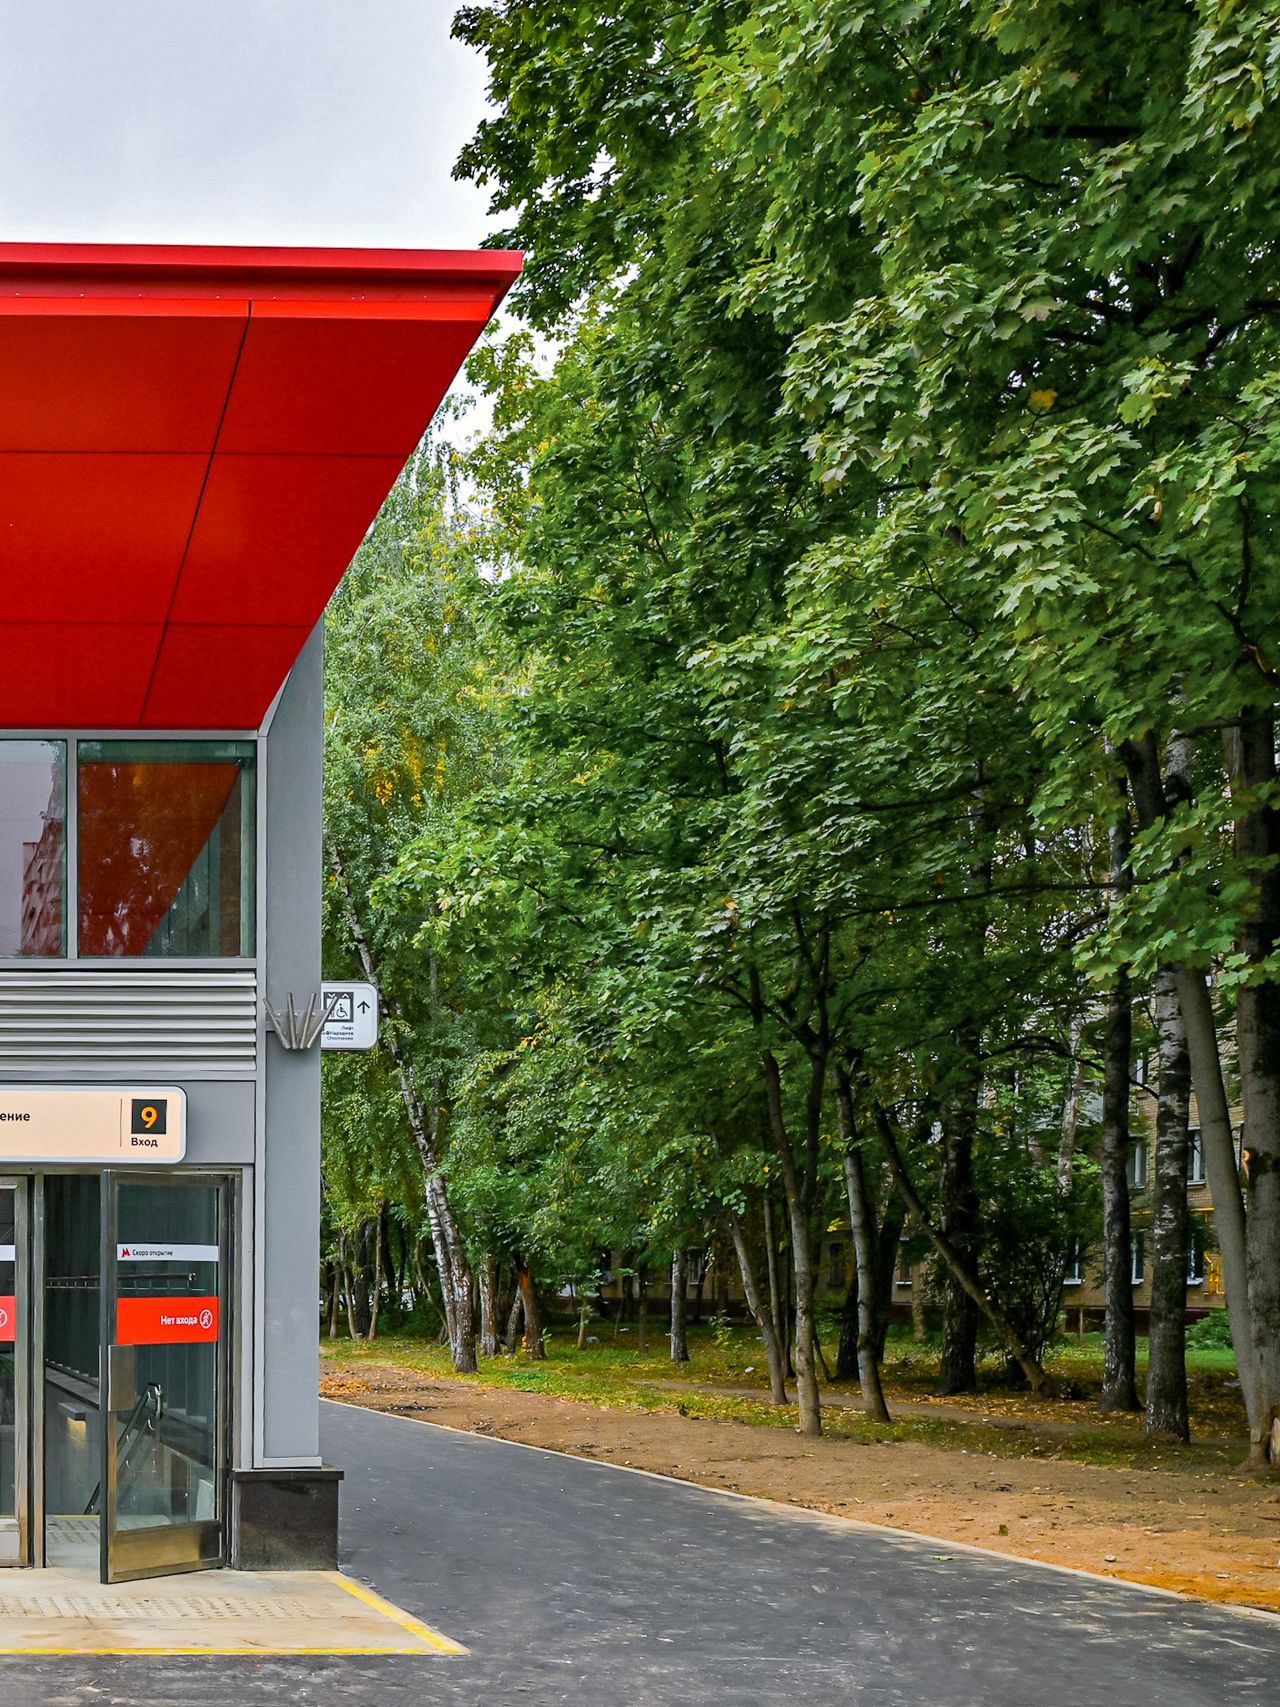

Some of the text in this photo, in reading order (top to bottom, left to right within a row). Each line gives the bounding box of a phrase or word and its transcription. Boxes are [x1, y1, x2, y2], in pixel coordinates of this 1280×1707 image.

[140, 1106, 158, 1129] 9
[131, 1137, 159, 1148] Вход
[160, 1315, 198, 1326] Нет входа
